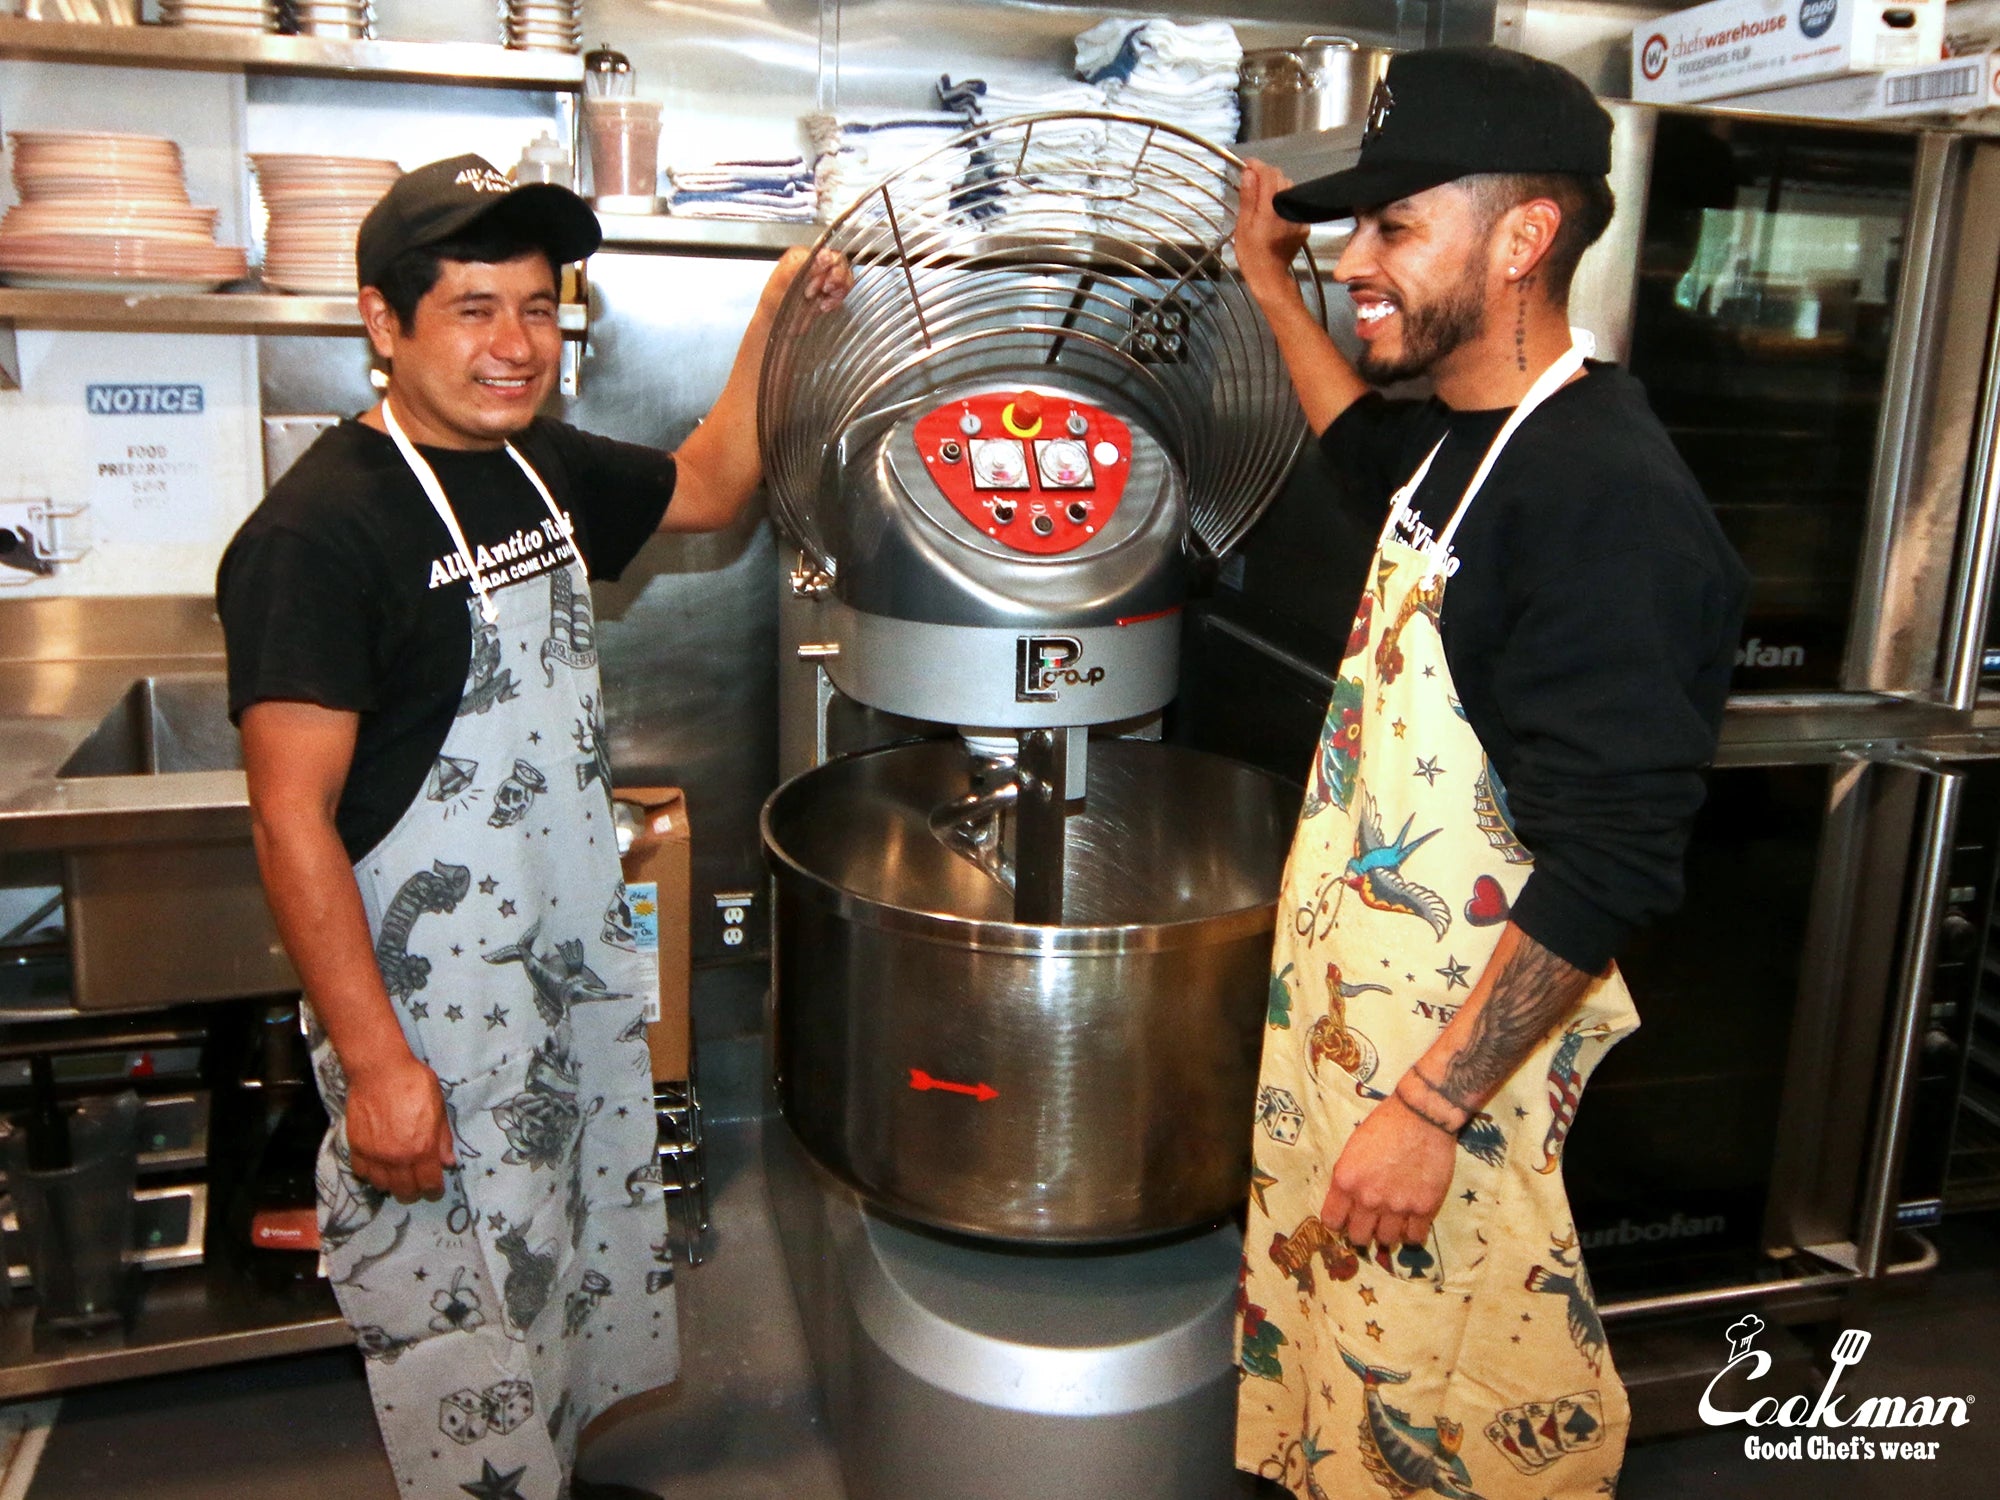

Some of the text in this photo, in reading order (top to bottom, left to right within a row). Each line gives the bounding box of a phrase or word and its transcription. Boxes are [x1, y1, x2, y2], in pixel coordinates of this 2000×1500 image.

[91, 387, 200, 412] NOTICE
[127, 445, 167, 459] FOOD
[429, 529, 543, 589] All Antico
[540, 551, 557, 568] LA
[1581, 1212, 1727, 1250] urbofan
